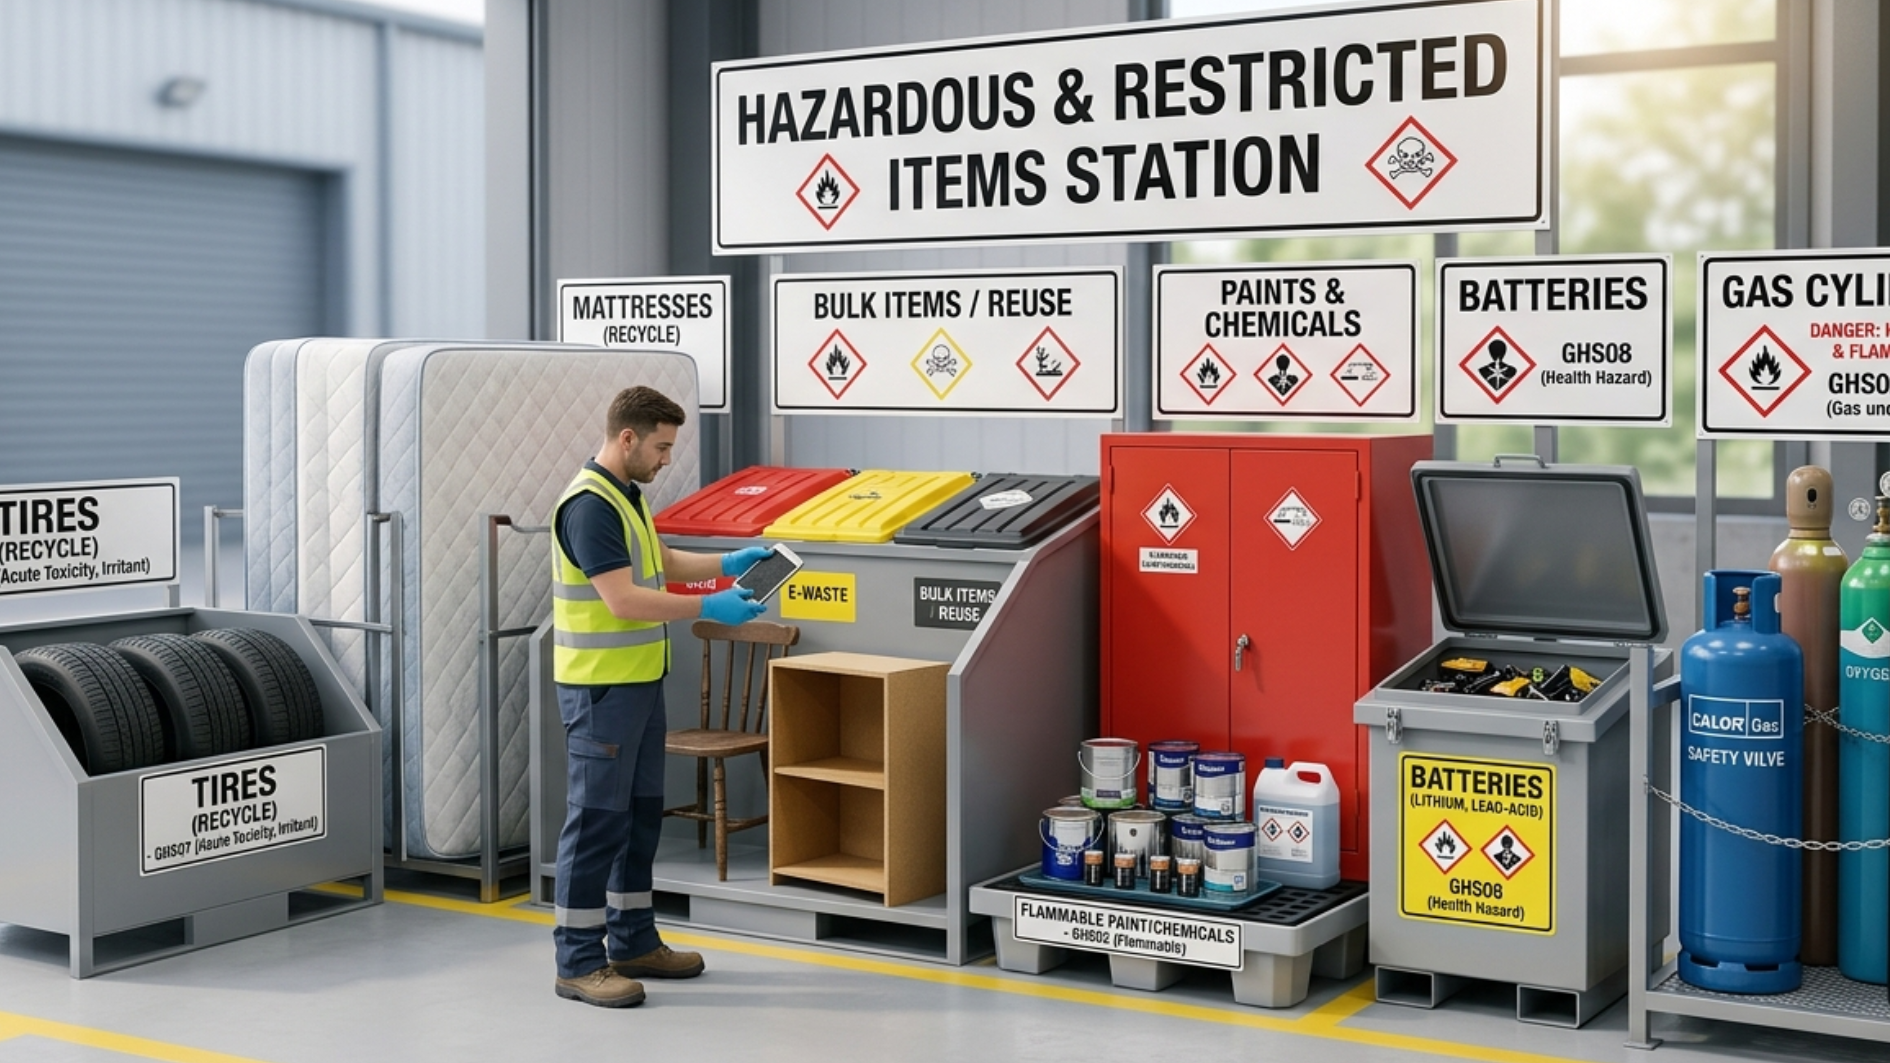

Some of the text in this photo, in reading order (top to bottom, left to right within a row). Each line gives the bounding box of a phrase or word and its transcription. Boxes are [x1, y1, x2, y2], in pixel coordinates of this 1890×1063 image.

[737, 32, 1507, 145] HAZARDOUS & RESTRICTED
[890, 134, 1319, 210] ITEMS STATION
[1222, 278, 1344, 305] PAINTS &
[1460, 277, 1647, 311] BATTERIES
[1723, 273, 1890, 308] GAS CYLI
[574, 293, 712, 319] MATTRESSES
[815, 289, 1072, 319] BULK ITEMS / REUSE
[604, 326, 680, 346] (RECYCLE)
[1206, 310, 1360, 337] CHEMICALS
[1810, 322, 1881, 338] DANGER:
[1563, 343, 1631, 363] GHS08
[1832, 343, 1845, 359] &
[1541, 370, 1652, 388] (Health Hazard)
[1826, 399, 1861, 419] (Gas
[0, 496, 99, 536] TIRES
[0, 536, 98, 565] (RECYCLE)
[0, 558, 150, 587] Acute Toxicity, Irritant)
[788, 584, 848, 602] E-WASTE
[919, 585, 997, 604] BULK ITEMS
[938, 605, 981, 623] REUSE
[1692, 712, 1779, 733] CALOR Gas
[1688, 745, 1785, 767] SAFETY VILVE
[191, 764, 277, 808] TIRES
[1411, 764, 1543, 799] BATTERIES
[1410, 793, 1469, 813] (LITHIUM,
[192, 800, 277, 837] (RECYCLE)
[1021, 902, 1104, 927] FLAMMABLE
